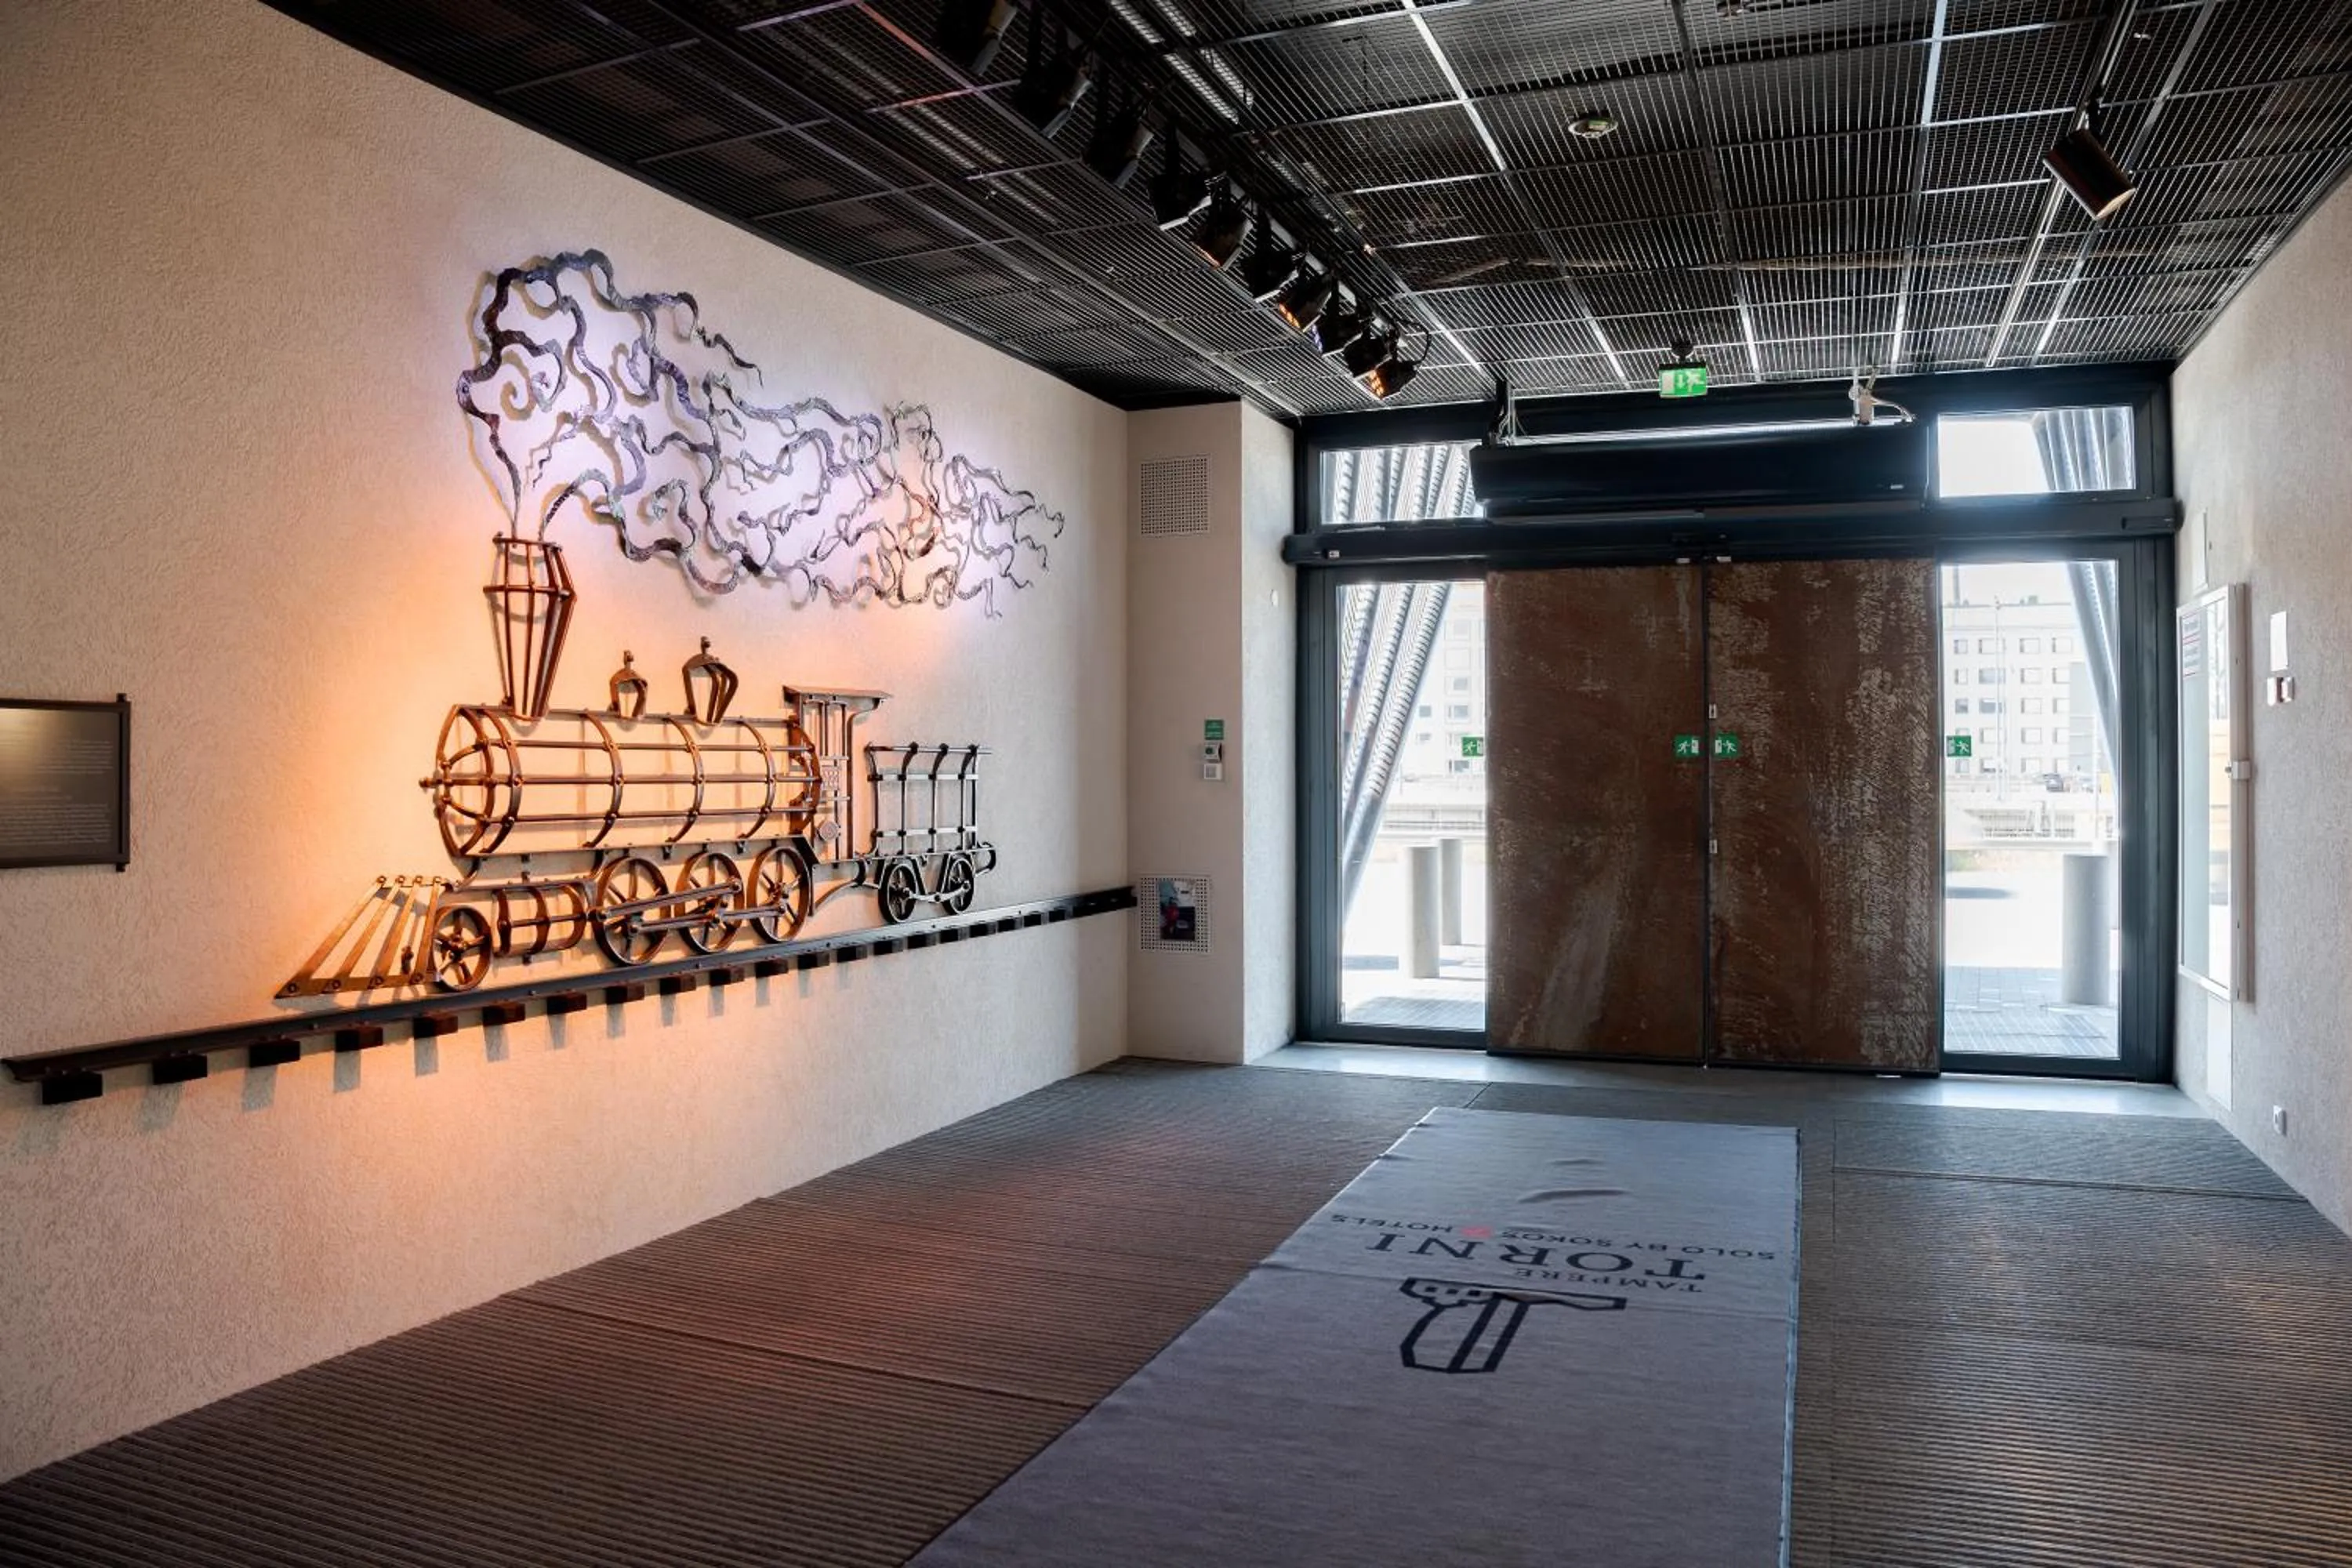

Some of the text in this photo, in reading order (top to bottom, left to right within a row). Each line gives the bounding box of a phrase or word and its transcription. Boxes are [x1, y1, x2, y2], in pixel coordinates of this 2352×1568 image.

[1330, 1214, 1775, 1260] SOLO BY SOKOS HOTELS
[1364, 1232, 1706, 1280] TORNI
[1515, 1268, 1702, 1292] TAMPERE
